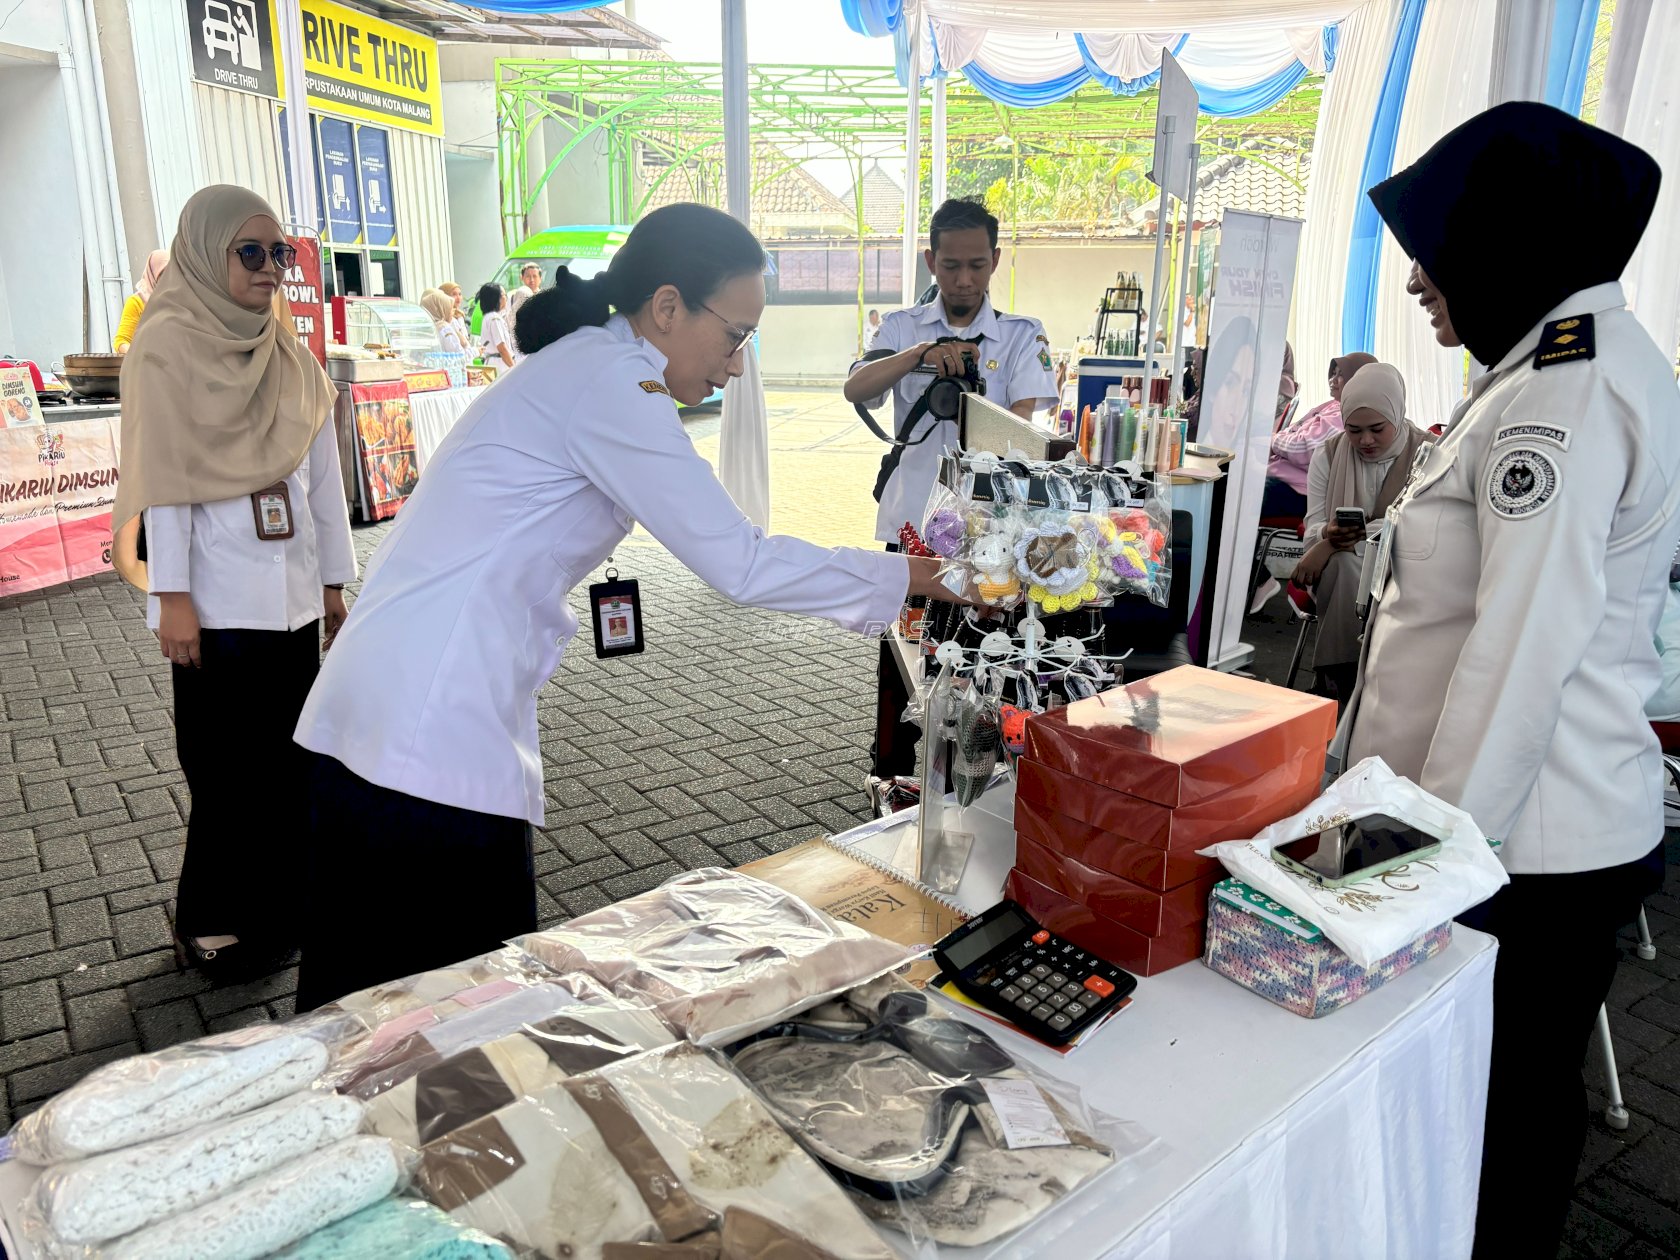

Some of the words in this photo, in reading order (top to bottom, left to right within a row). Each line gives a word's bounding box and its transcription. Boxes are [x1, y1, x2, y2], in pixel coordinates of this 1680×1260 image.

[302, 9, 363, 75] RIVE
[367, 32, 429, 93] THRU
[214, 67, 238, 85] DRIVE
[238, 73, 259, 90] THRU
[305, 76, 357, 102] RPUSTAKAAN
[358, 90, 382, 107] UMUM
[382, 97, 402, 113] KOTA
[402, 103, 431, 120] MALANG
[1499, 427, 1564, 441] KEMENIMIPAS
[833, 893, 907, 923] Kata
[1006, 986, 1015, 995] 7
[1021, 976, 1032, 984] 8
[1036, 966, 1046, 974] 9
[1023, 996, 1033, 1004] 4
[1053, 994, 1064, 1002] 2
[1055, 1015, 1065, 1023] 0
[1068, 1002, 1082, 1013] 00
